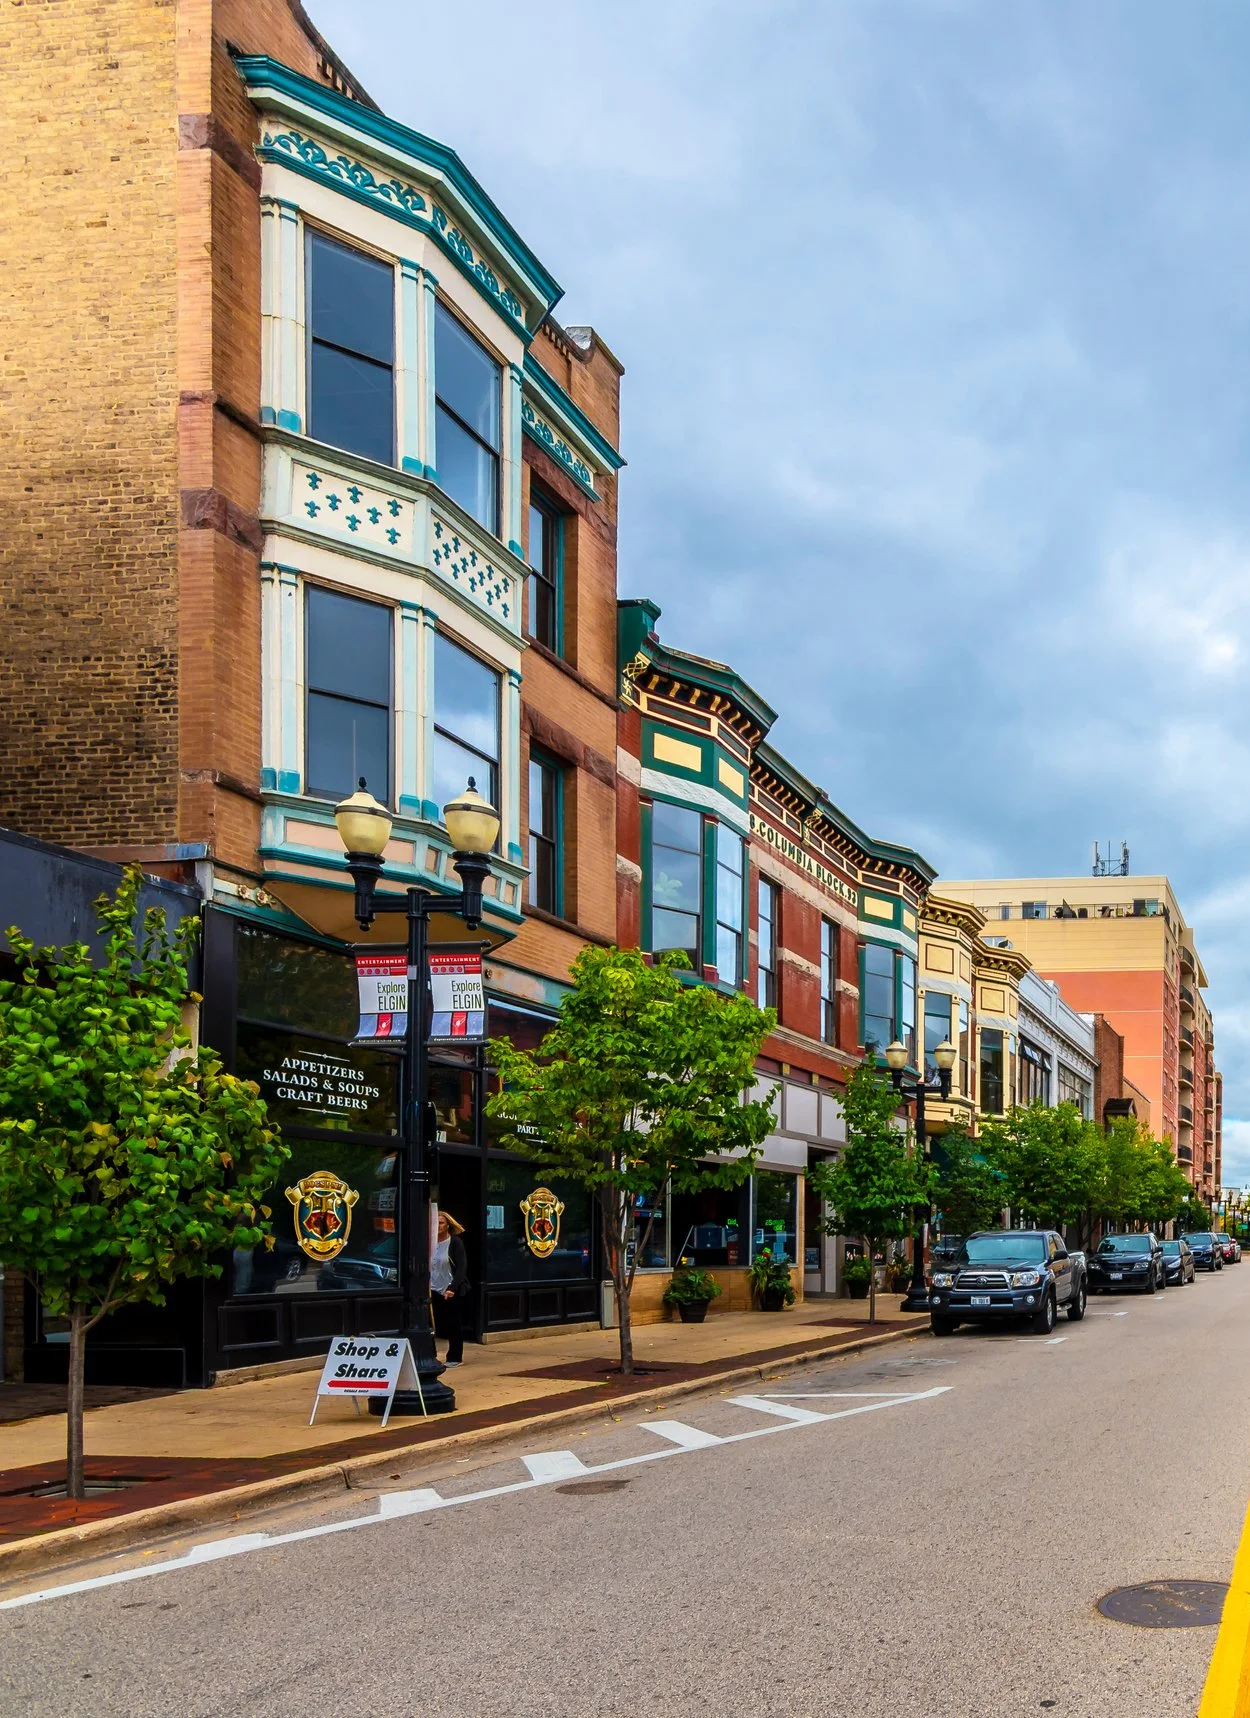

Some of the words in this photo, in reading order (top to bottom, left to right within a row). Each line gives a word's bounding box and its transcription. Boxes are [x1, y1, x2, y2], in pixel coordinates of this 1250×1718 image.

[377, 981, 406, 995] Explore
[451, 979, 480, 993] Explore
[378, 995, 406, 1011] ELGIN
[452, 994, 482, 1010] ELGIN
[281, 1057, 365, 1081] APPETIZERS
[263, 1069, 318, 1088] SALADS
[322, 1079, 334, 1091] &
[338, 1081, 380, 1098] SOUPS
[276, 1087, 323, 1104] CRAFT
[327, 1094, 368, 1110] BEERS
[334, 1342, 380, 1360] Shop
[384, 1343, 399, 1357] &
[334, 1363, 388, 1378] Share
